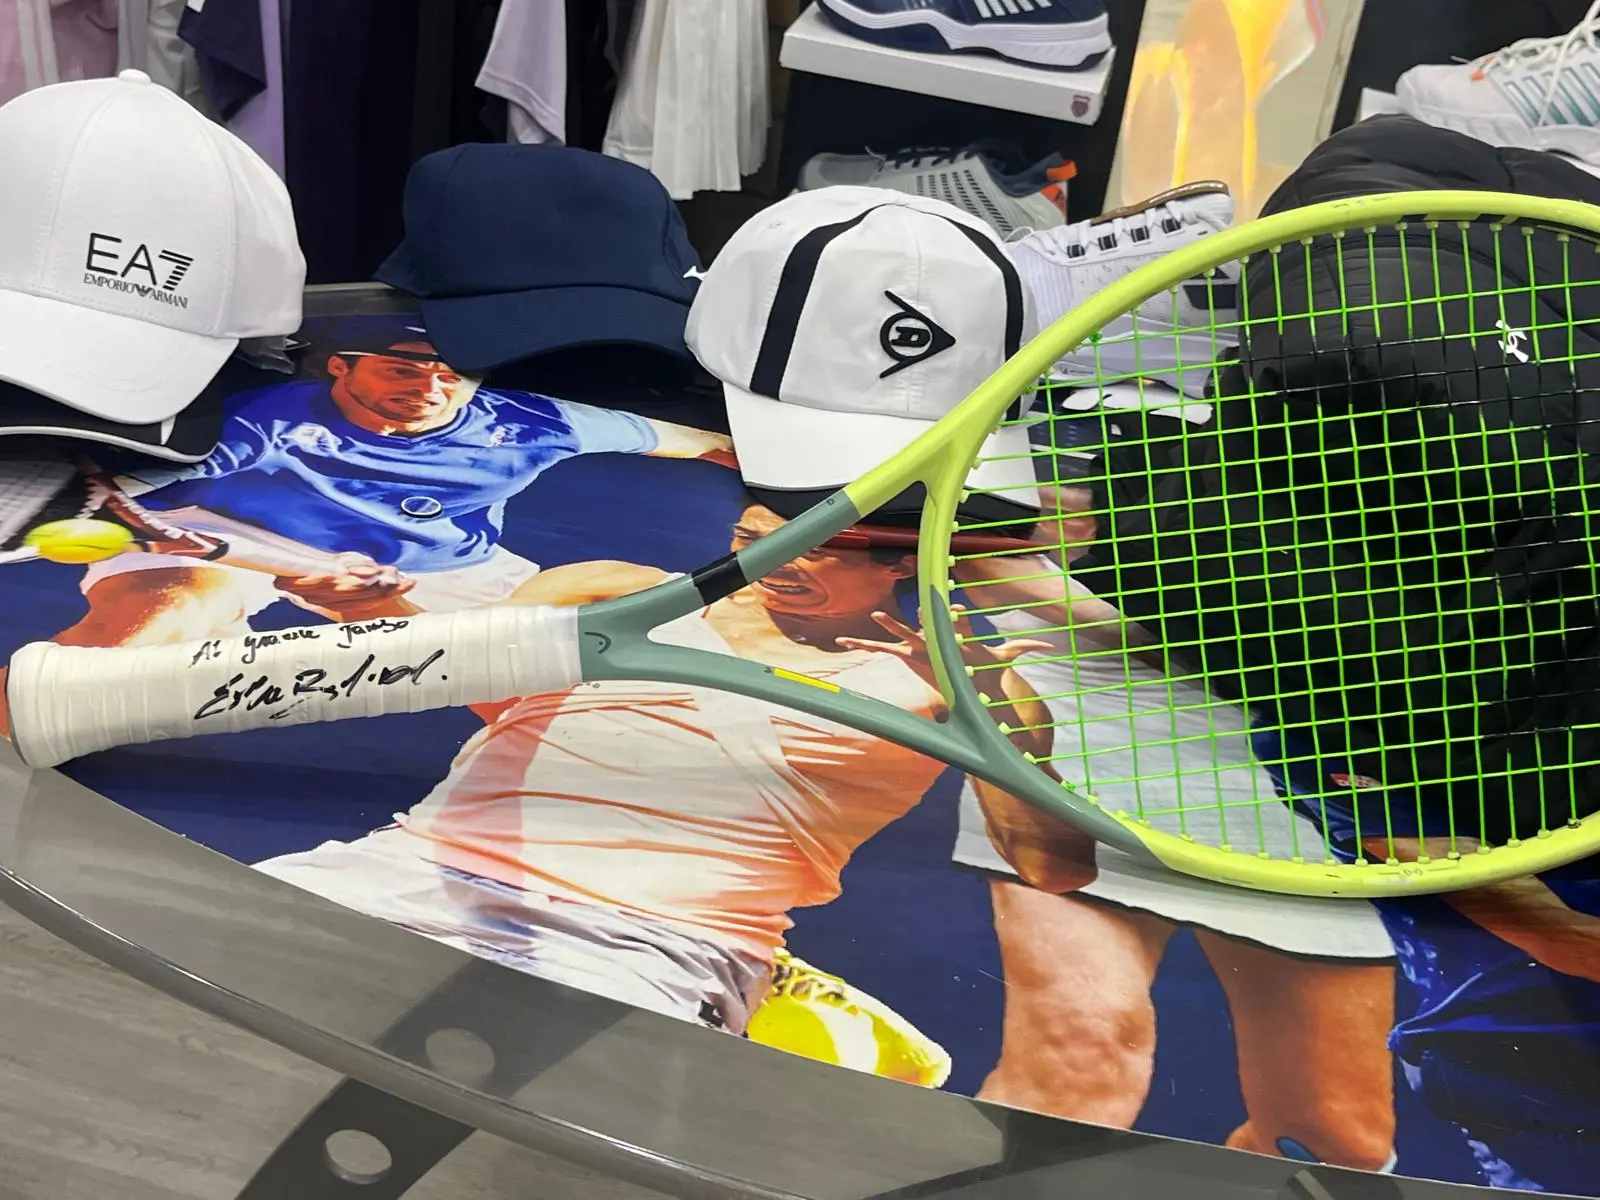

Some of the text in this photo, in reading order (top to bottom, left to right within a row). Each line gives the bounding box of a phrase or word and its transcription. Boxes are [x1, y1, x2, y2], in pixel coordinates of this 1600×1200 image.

[86, 232, 194, 291] EA7
[83, 272, 188, 309] EMPORIO ARMANI
